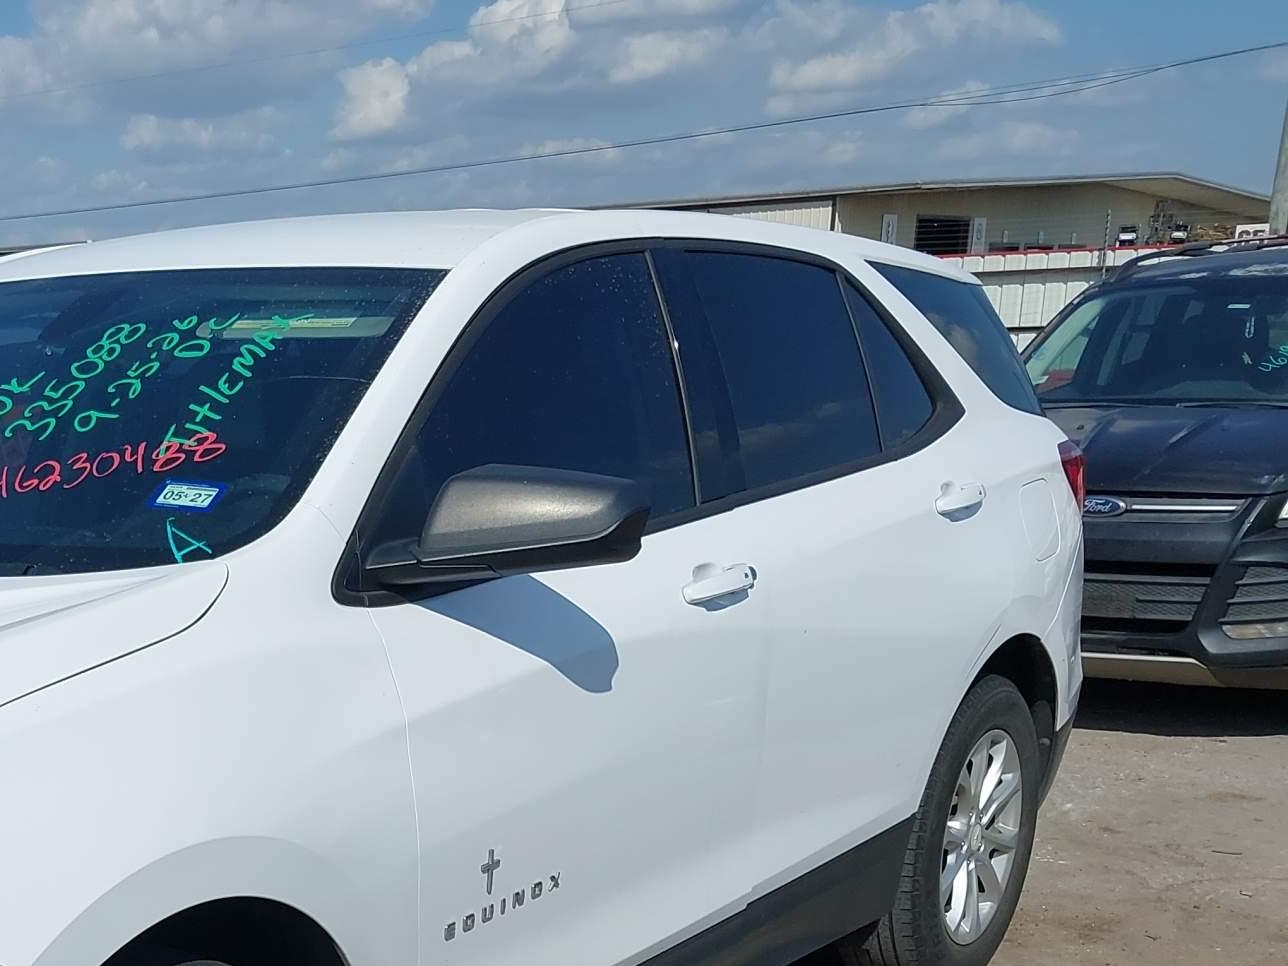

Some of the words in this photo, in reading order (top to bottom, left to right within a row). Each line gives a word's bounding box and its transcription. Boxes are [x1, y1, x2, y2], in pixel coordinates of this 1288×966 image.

[5, 323, 146, 440] 335088
[163, 490, 185, 501] 05
[189, 492, 213, 504] 27
[1083, 498, 1114, 513] Ford
[167, 517, 212, 565] A
[444, 872, 561, 942] EQUINOX
